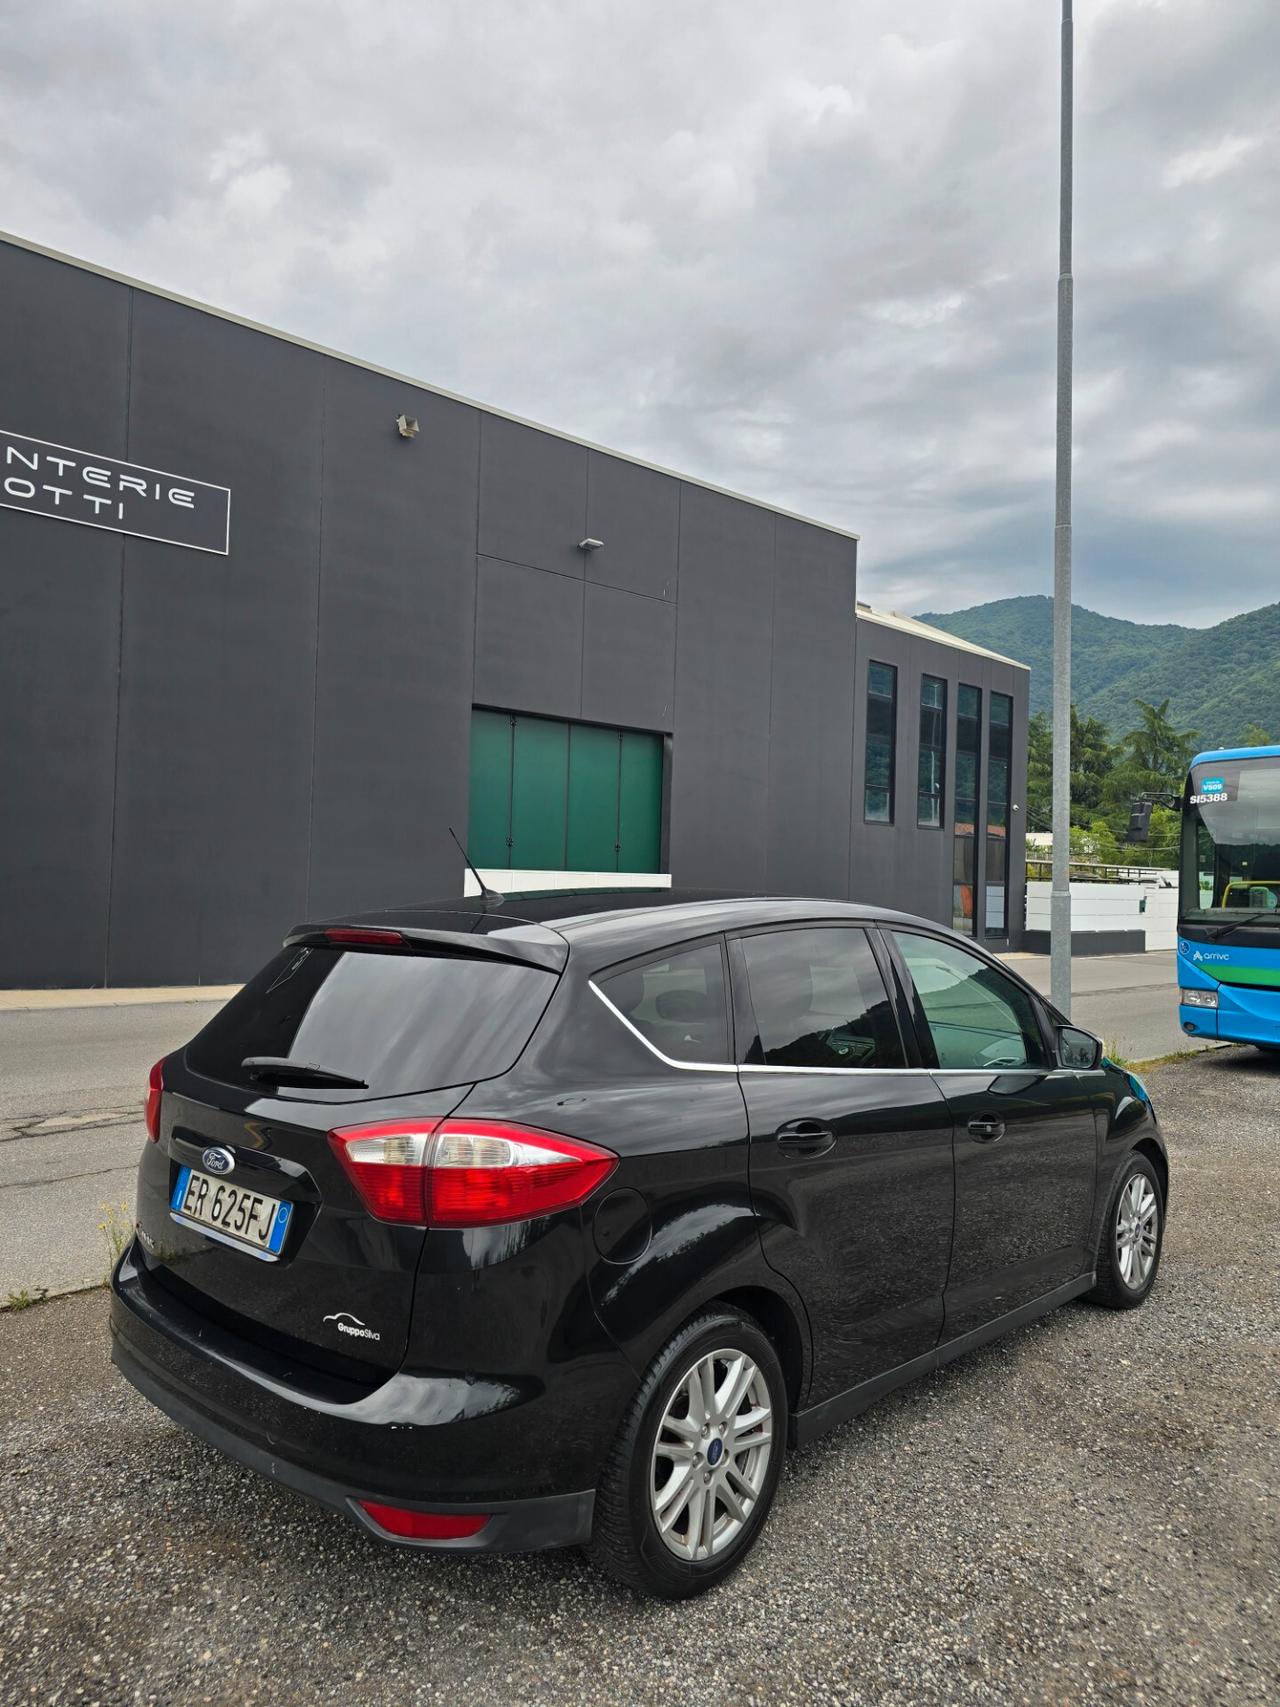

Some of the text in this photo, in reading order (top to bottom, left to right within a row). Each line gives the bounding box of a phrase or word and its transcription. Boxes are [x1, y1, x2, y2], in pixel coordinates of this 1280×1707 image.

[4, 477, 124, 520] OTTI
[6, 446, 195, 509] NTERIE
[207, 1152, 225, 1169] Ford
[183, 1174, 209, 1216] ER
[211, 1185, 276, 1240] 625FJ
